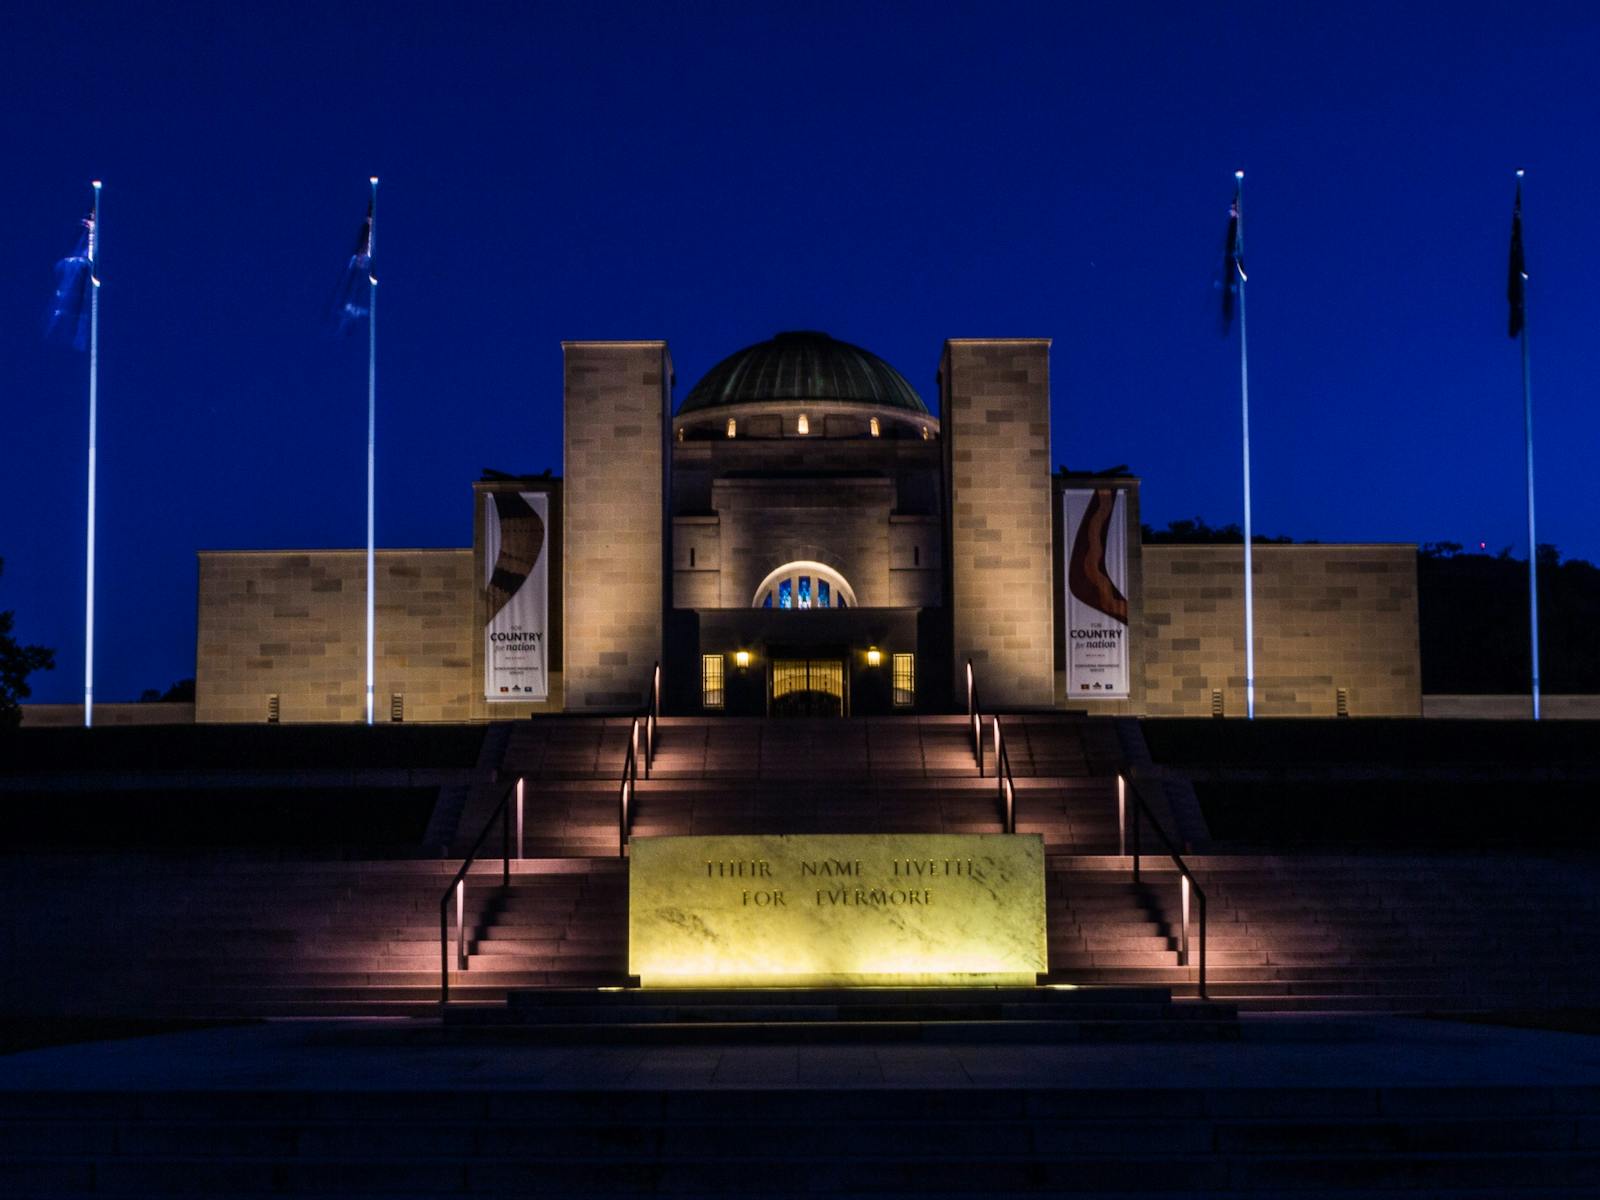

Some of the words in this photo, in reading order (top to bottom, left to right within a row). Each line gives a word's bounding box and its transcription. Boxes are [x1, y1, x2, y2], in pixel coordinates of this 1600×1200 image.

[490, 632, 543, 641] COUNTRY
[1070, 630, 1122, 639] COUNTRY
[506, 642, 536, 651] nation
[1086, 639, 1116, 649] nation
[705, 860, 772, 878] THEIR
[801, 859, 862, 877] NAME
[893, 858, 974, 876] LIVETH
[742, 889, 786, 906] FOR
[816, 888, 934, 906] EVERMORE
